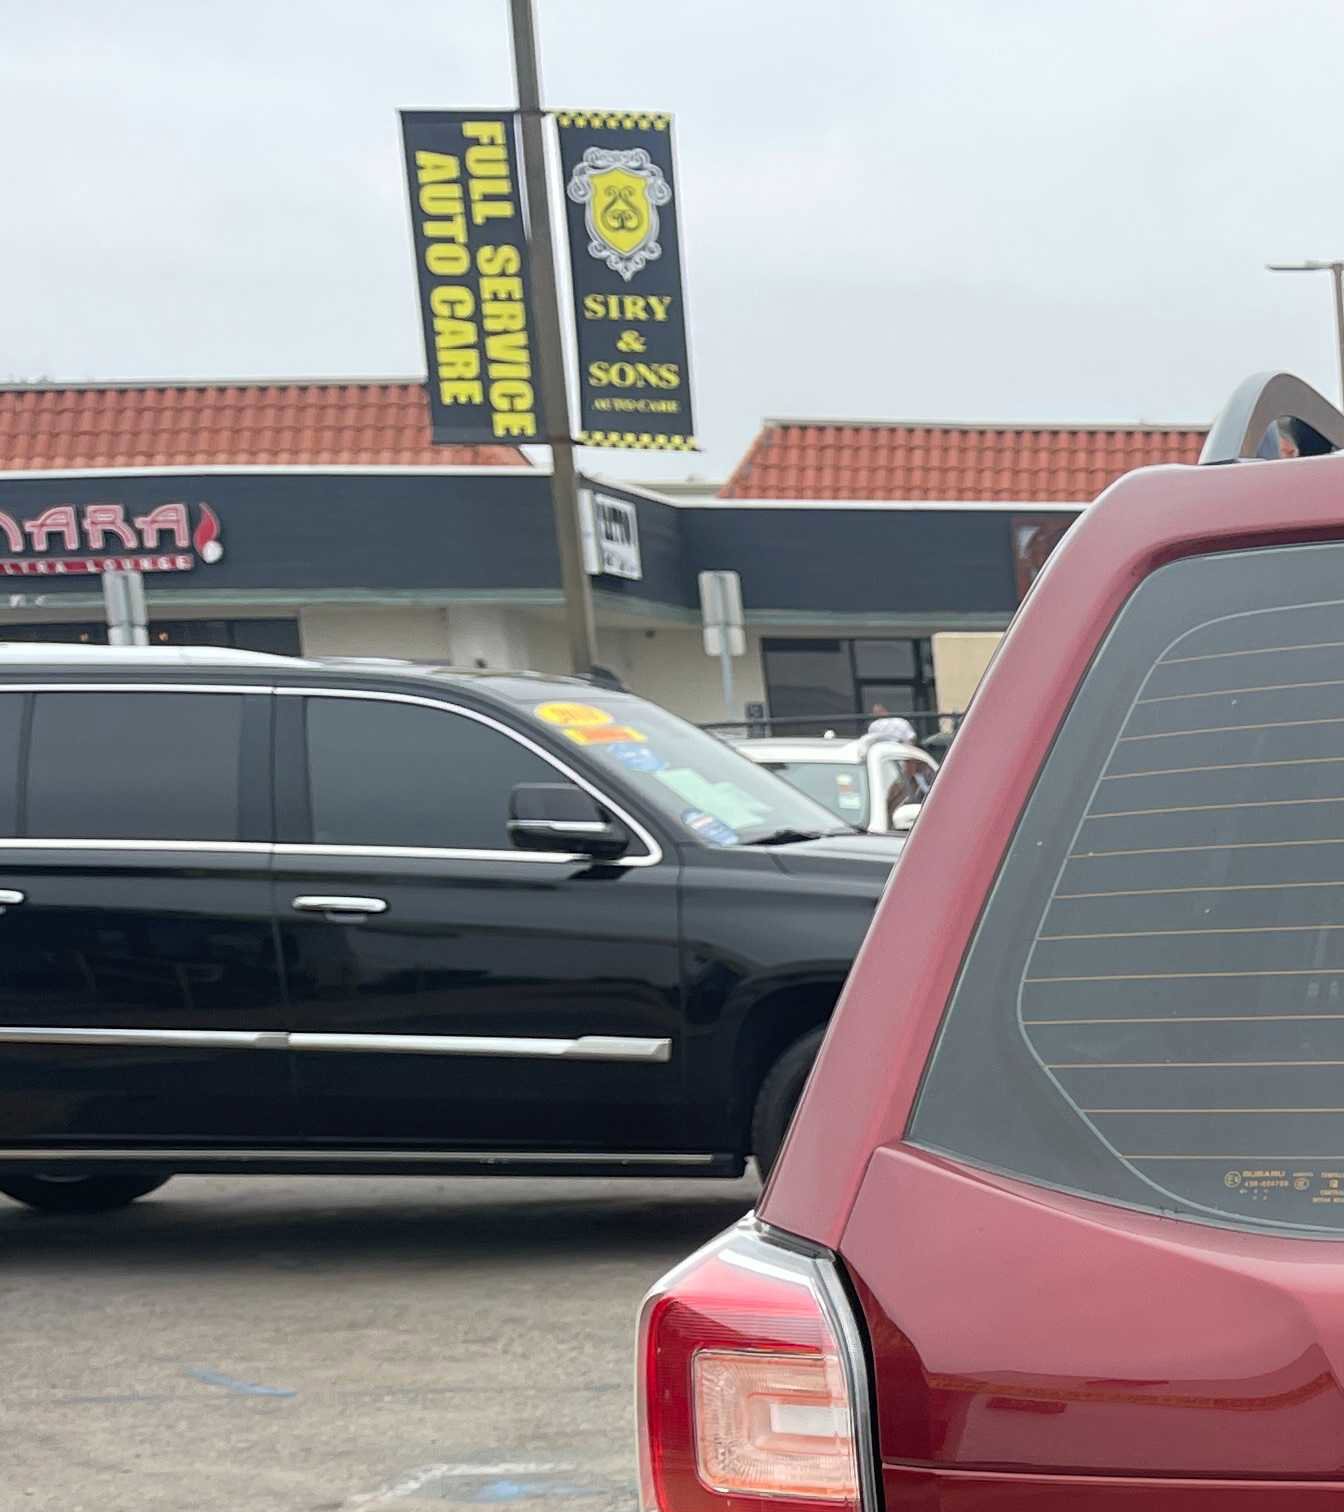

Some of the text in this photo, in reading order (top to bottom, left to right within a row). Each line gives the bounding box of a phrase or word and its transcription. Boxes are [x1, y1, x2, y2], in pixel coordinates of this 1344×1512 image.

[415, 151, 483, 406] AUTO CARE
[462, 121, 536, 437] FULL SERVICE
[583, 294, 673, 321] SIRY
[616, 329, 647, 352] &
[588, 361, 680, 390] SONS
[0, 503, 190, 551] ARA
